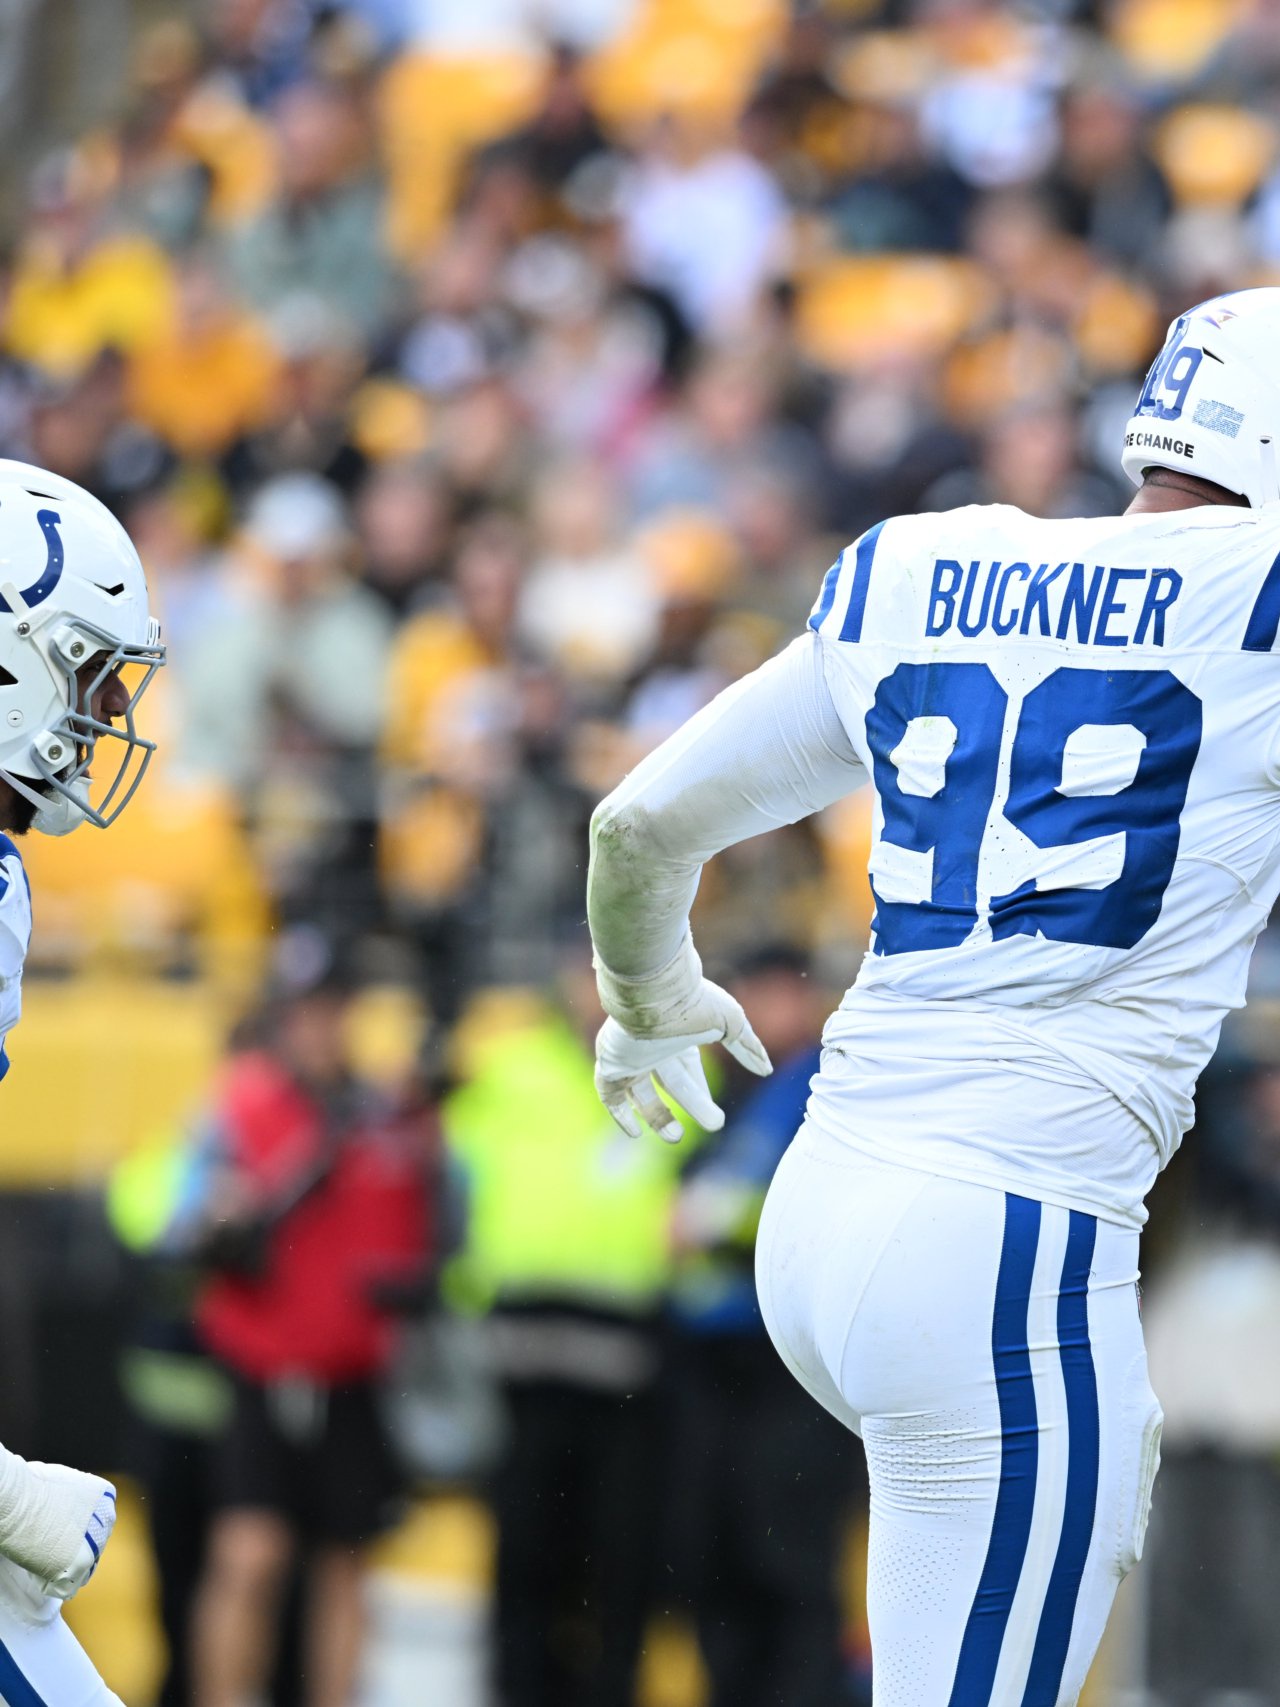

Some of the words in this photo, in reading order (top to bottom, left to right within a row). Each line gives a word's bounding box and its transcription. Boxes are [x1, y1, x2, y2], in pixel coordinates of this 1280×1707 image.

[1136, 433, 1195, 458] CHANGE
[925, 558, 1183, 647] BUCKNER
[865, 662, 1203, 956] 99
